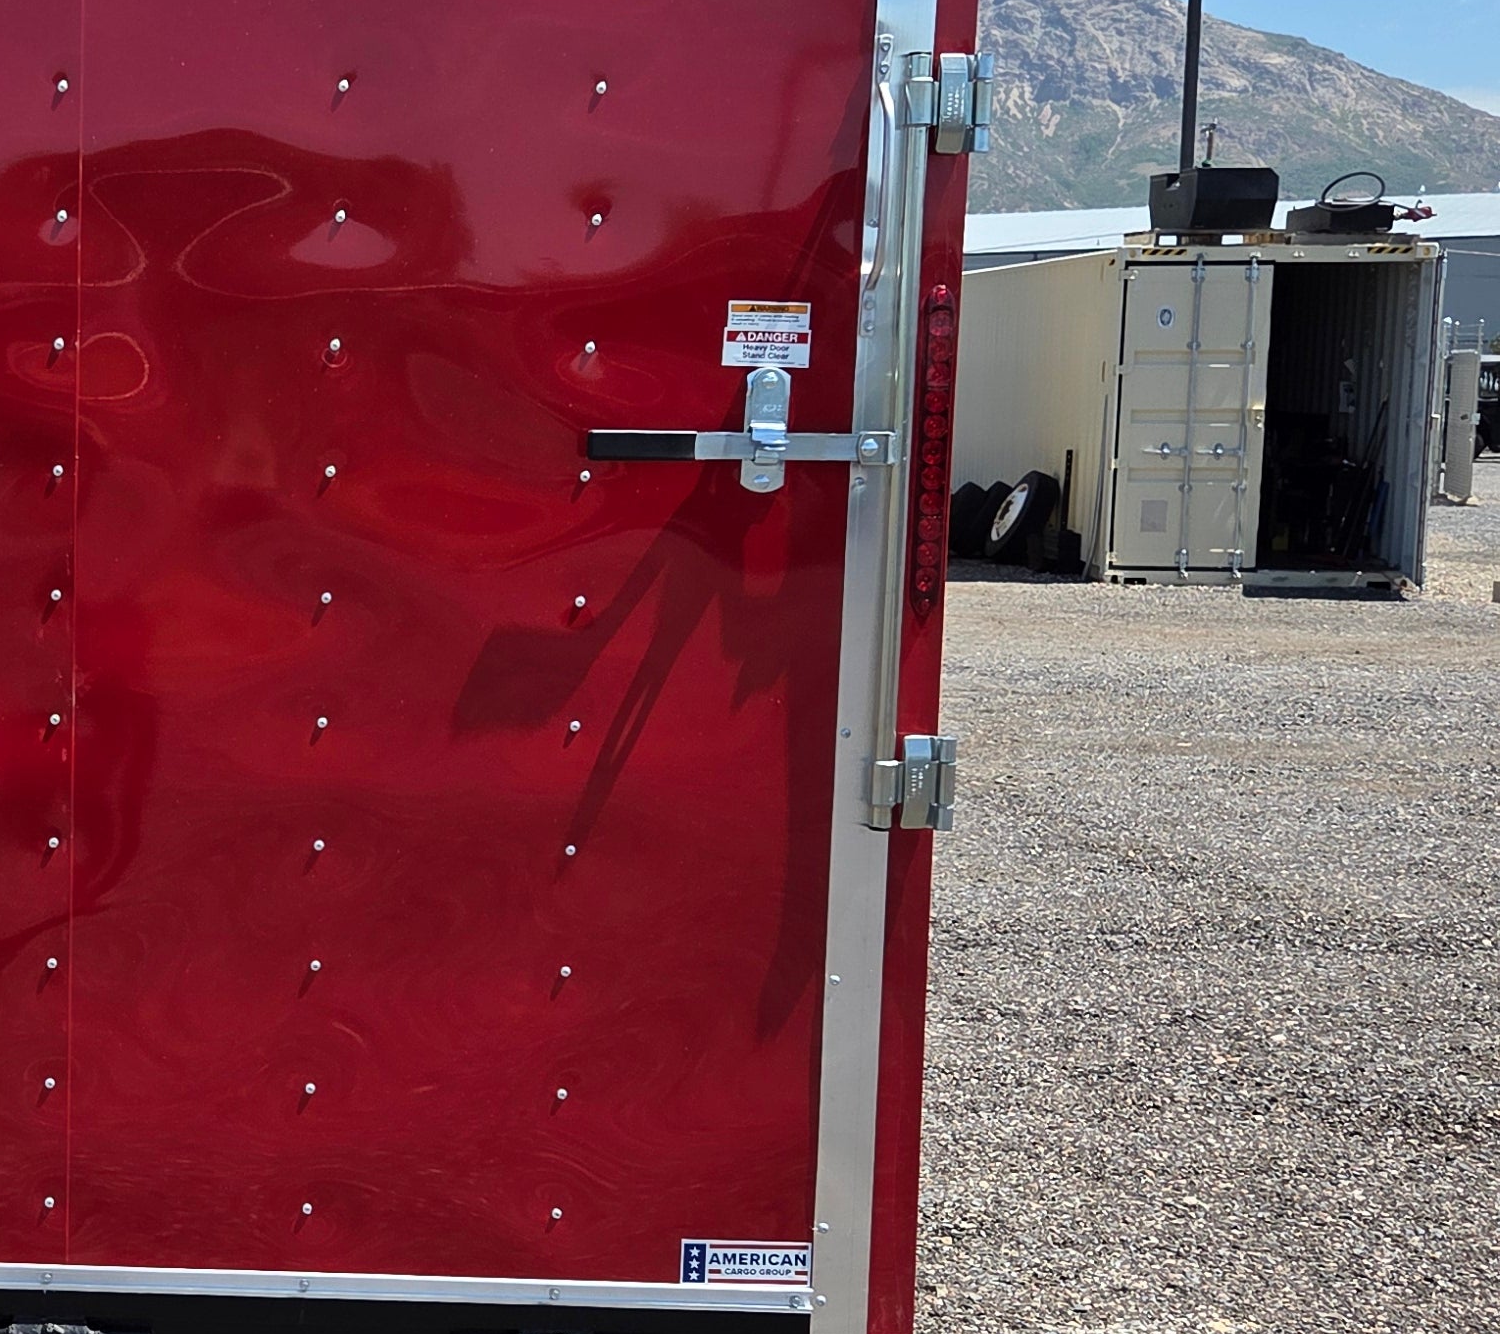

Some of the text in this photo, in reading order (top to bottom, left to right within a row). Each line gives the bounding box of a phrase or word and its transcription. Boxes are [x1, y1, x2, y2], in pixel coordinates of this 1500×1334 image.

[747, 332, 798, 342] DANGER
[743, 344, 767, 352] Heavy
[708, 1253, 807, 1266] AMERICAN
[724, 1268, 792, 1276] CARGO GROUP
